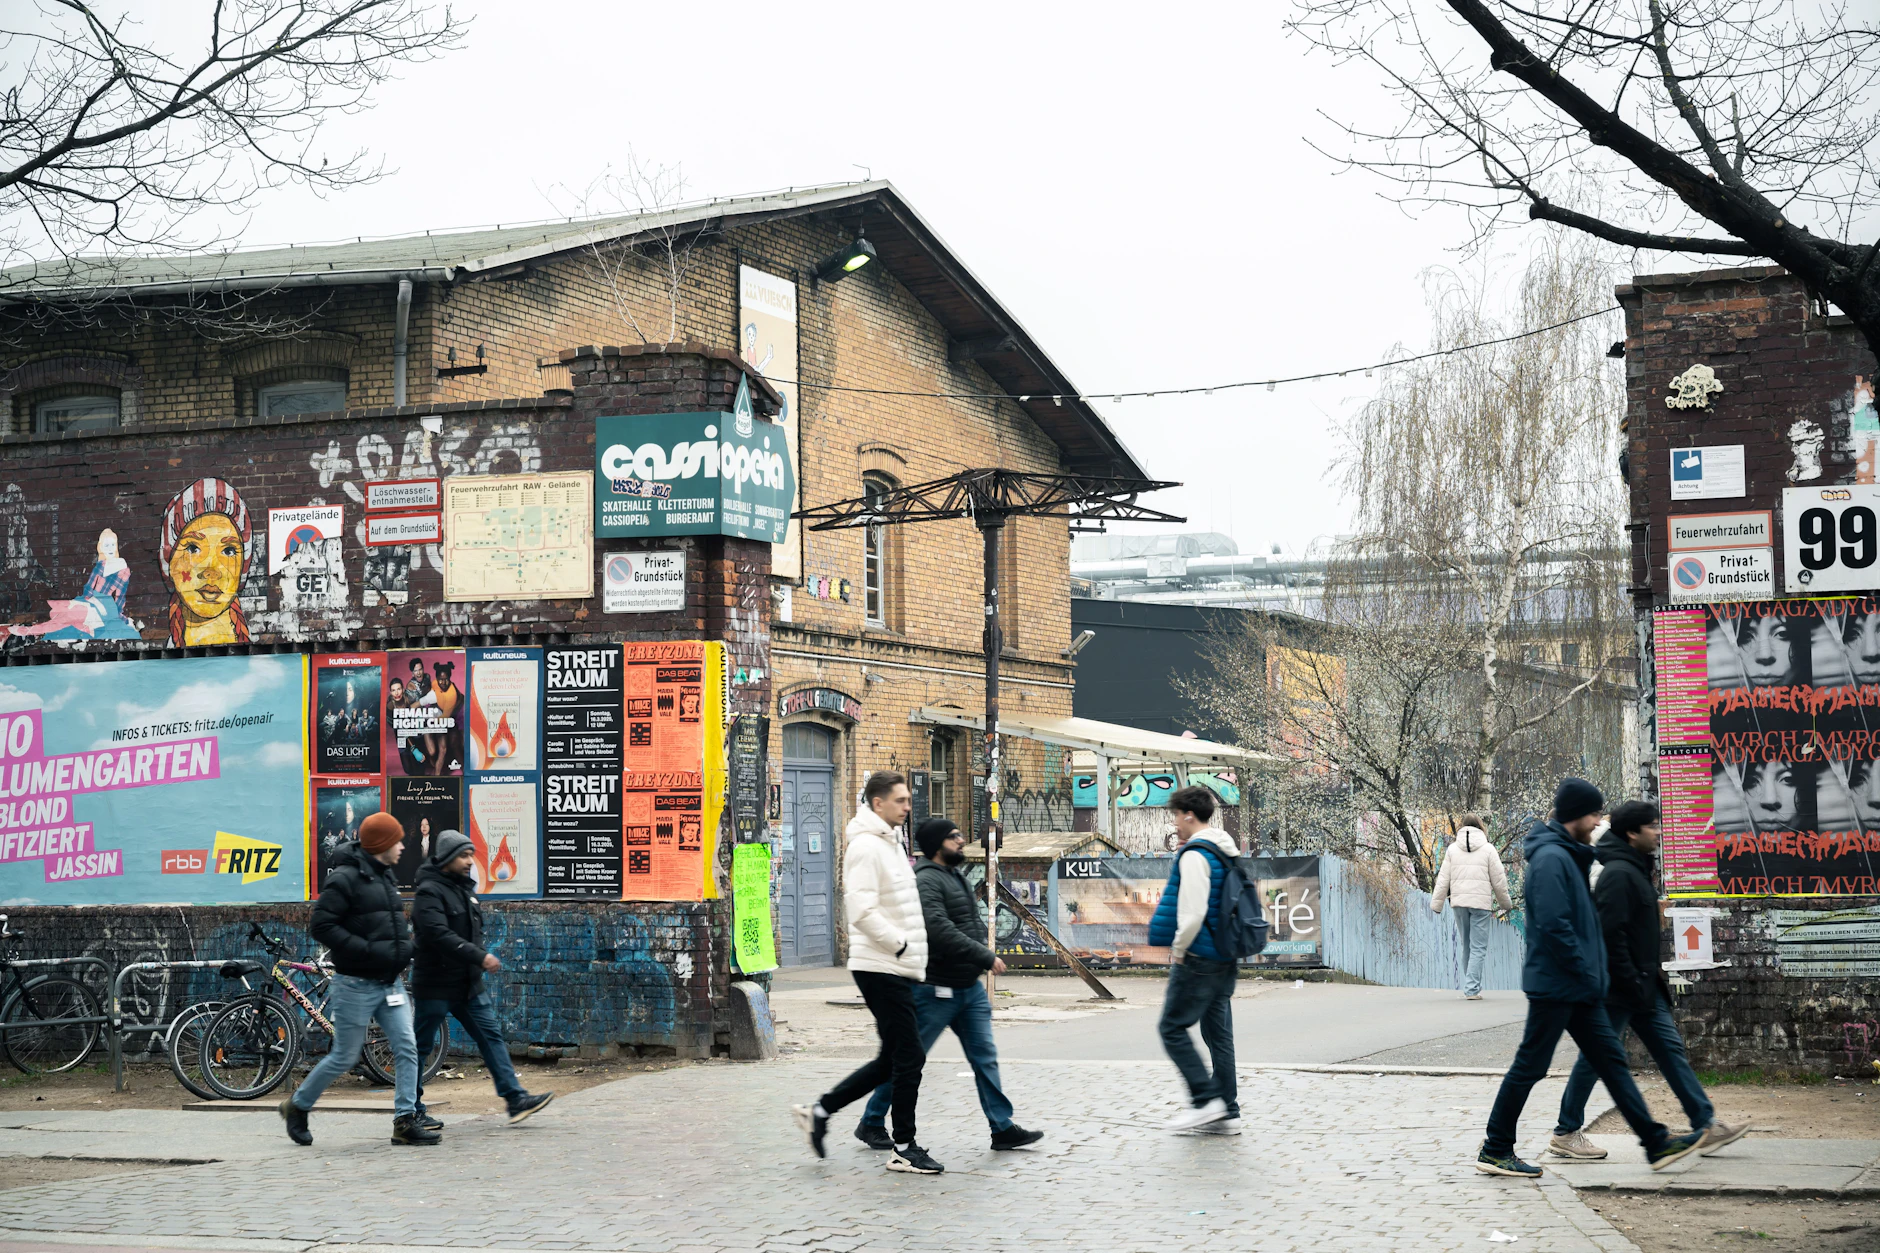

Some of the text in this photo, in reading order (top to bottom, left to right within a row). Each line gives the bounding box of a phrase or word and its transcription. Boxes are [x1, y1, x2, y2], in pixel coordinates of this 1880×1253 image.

[601, 424, 784, 493] cassiopeia
[374, 486, 431, 497] Löschwasser-
[450, 480, 581, 494] Feuerwehrzufahrt RAW Gelände
[203, 496, 214, 513] NO
[372, 494, 434, 505] entnahmestelle
[602, 498, 714, 512] SKATEHALLE KLETTERTURM
[272, 510, 339, 522] Privatgelände
[602, 512, 714, 526] CASSIOPEIA BURGERAMT
[370, 523, 437, 535] Auf dem Grundstück
[1676, 524, 1764, 539] Feuerwehrzufahrt
[1799, 506, 1877, 570] 99
[644, 557, 674, 568] Privat-
[1720, 555, 1759, 568] Privat-
[634, 570, 683, 582] Grundstück
[1708, 570, 1770, 584] Grundstück
[662, 588, 684, 597] Fahrzeuge
[547, 650, 618, 669] STREIT
[627, 645, 704, 660] GREYZONE
[548, 669, 608, 688] RAUM
[720, 647, 728, 730] KULTURBOARD
[629, 700, 651, 710] MIKE
[112, 711, 274, 742] INFOS & TICKETS: fritz.de/openair
[393, 718, 455, 729] FIGHT CLUB
[488, 721, 517, 730] Dream
[490, 731, 516, 739] Count
[327, 747, 370, 756] DAS LICHT
[547, 775, 618, 794] STREIT
[626, 773, 702, 788] GREYZONE
[407, 781, 423, 796] Lucy
[548, 794, 608, 812] RAUM
[628, 828, 650, 838] MIKE
[489, 845, 518, 853] Dream
[165, 854, 202, 870] rbb
[214, 848, 283, 874] FRITZ
[490, 854, 516, 862] Count
[49, 851, 118, 880] JASSIN
[1065, 862, 1102, 876] KULT
[1809, 876, 1820, 894] 7
[748, 898, 767, 910] BEGIN?
[287, 986, 334, 1031] TECNOBIKE
